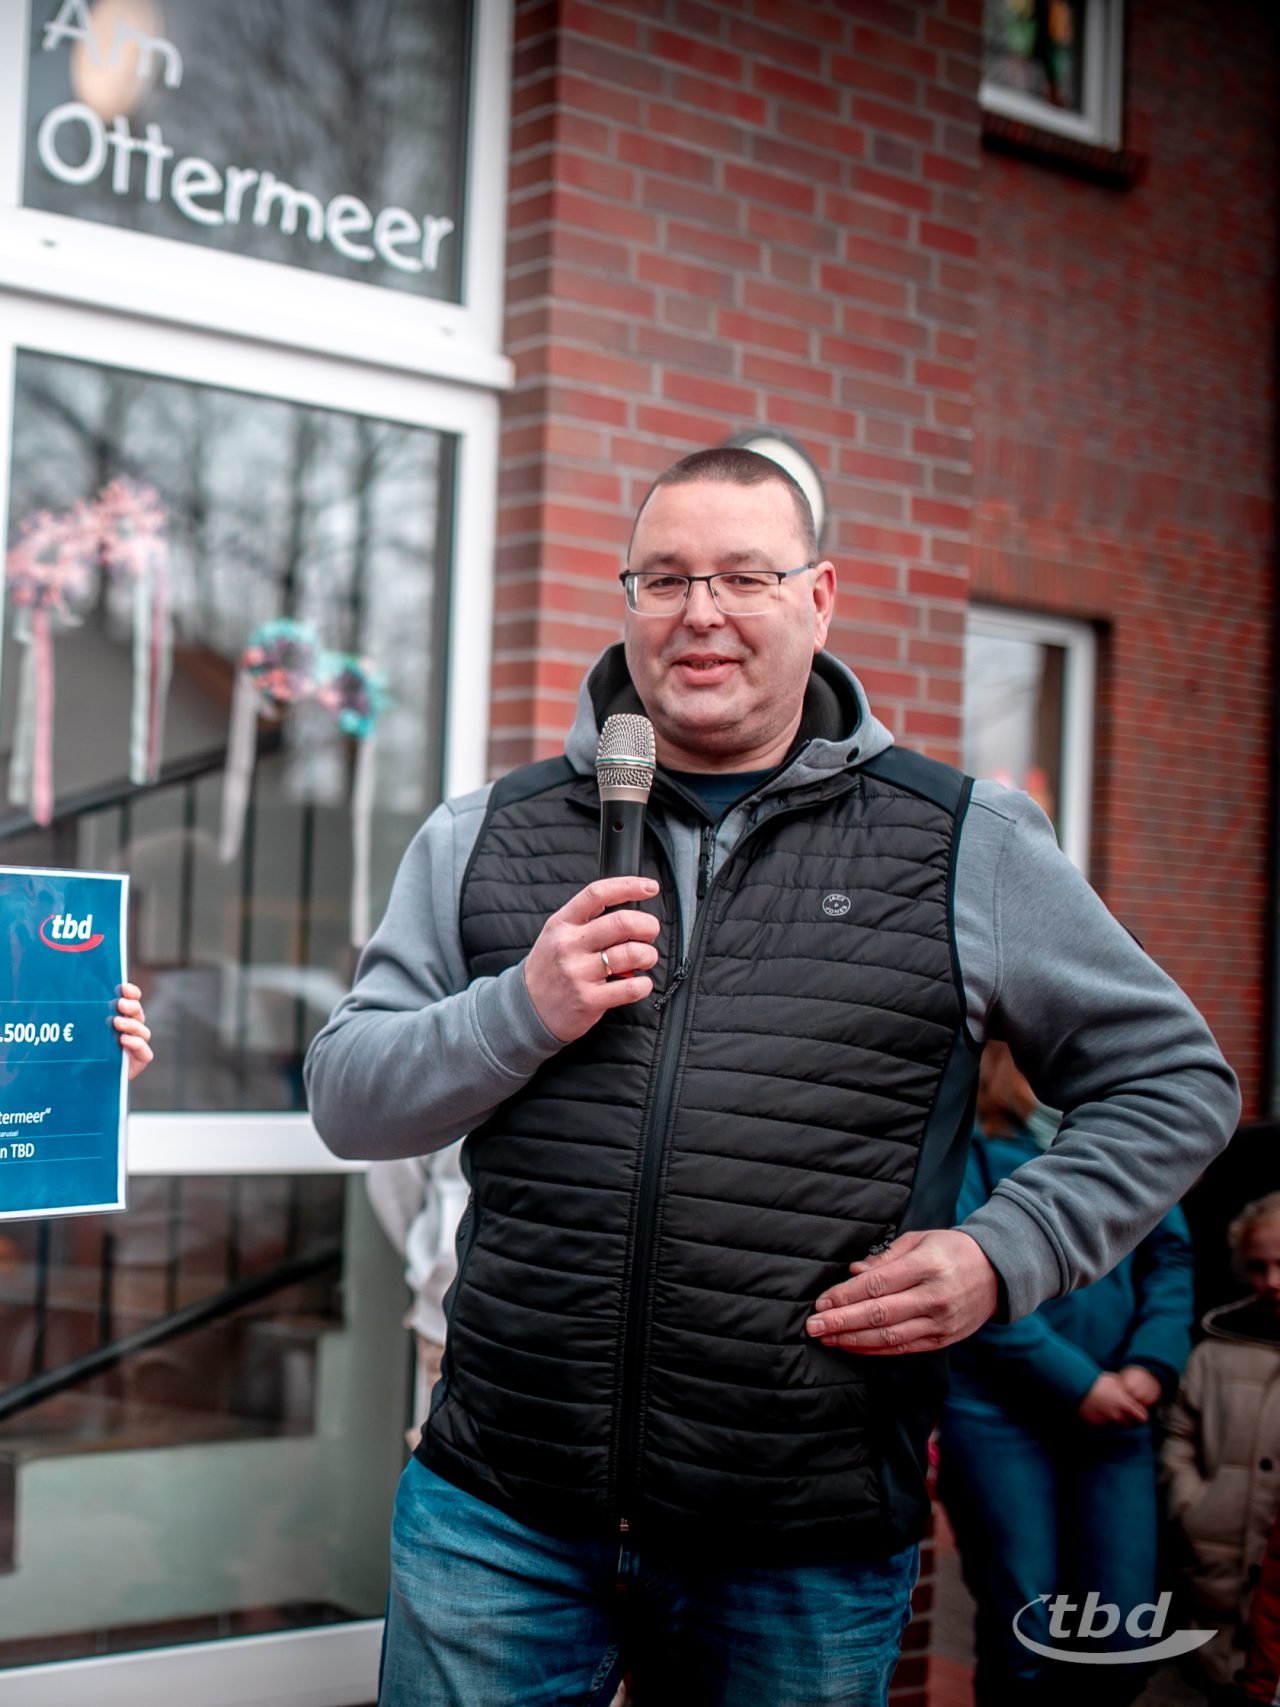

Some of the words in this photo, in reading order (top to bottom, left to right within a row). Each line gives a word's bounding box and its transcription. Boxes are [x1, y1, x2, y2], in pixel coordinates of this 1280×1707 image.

[42, 0, 183, 88] Am
[38, 101, 454, 272] Ottermeer
[51, 913, 93, 940] tbd
[63, 1023, 74, 1042] €
[10, 1143, 35, 1158] TBD
